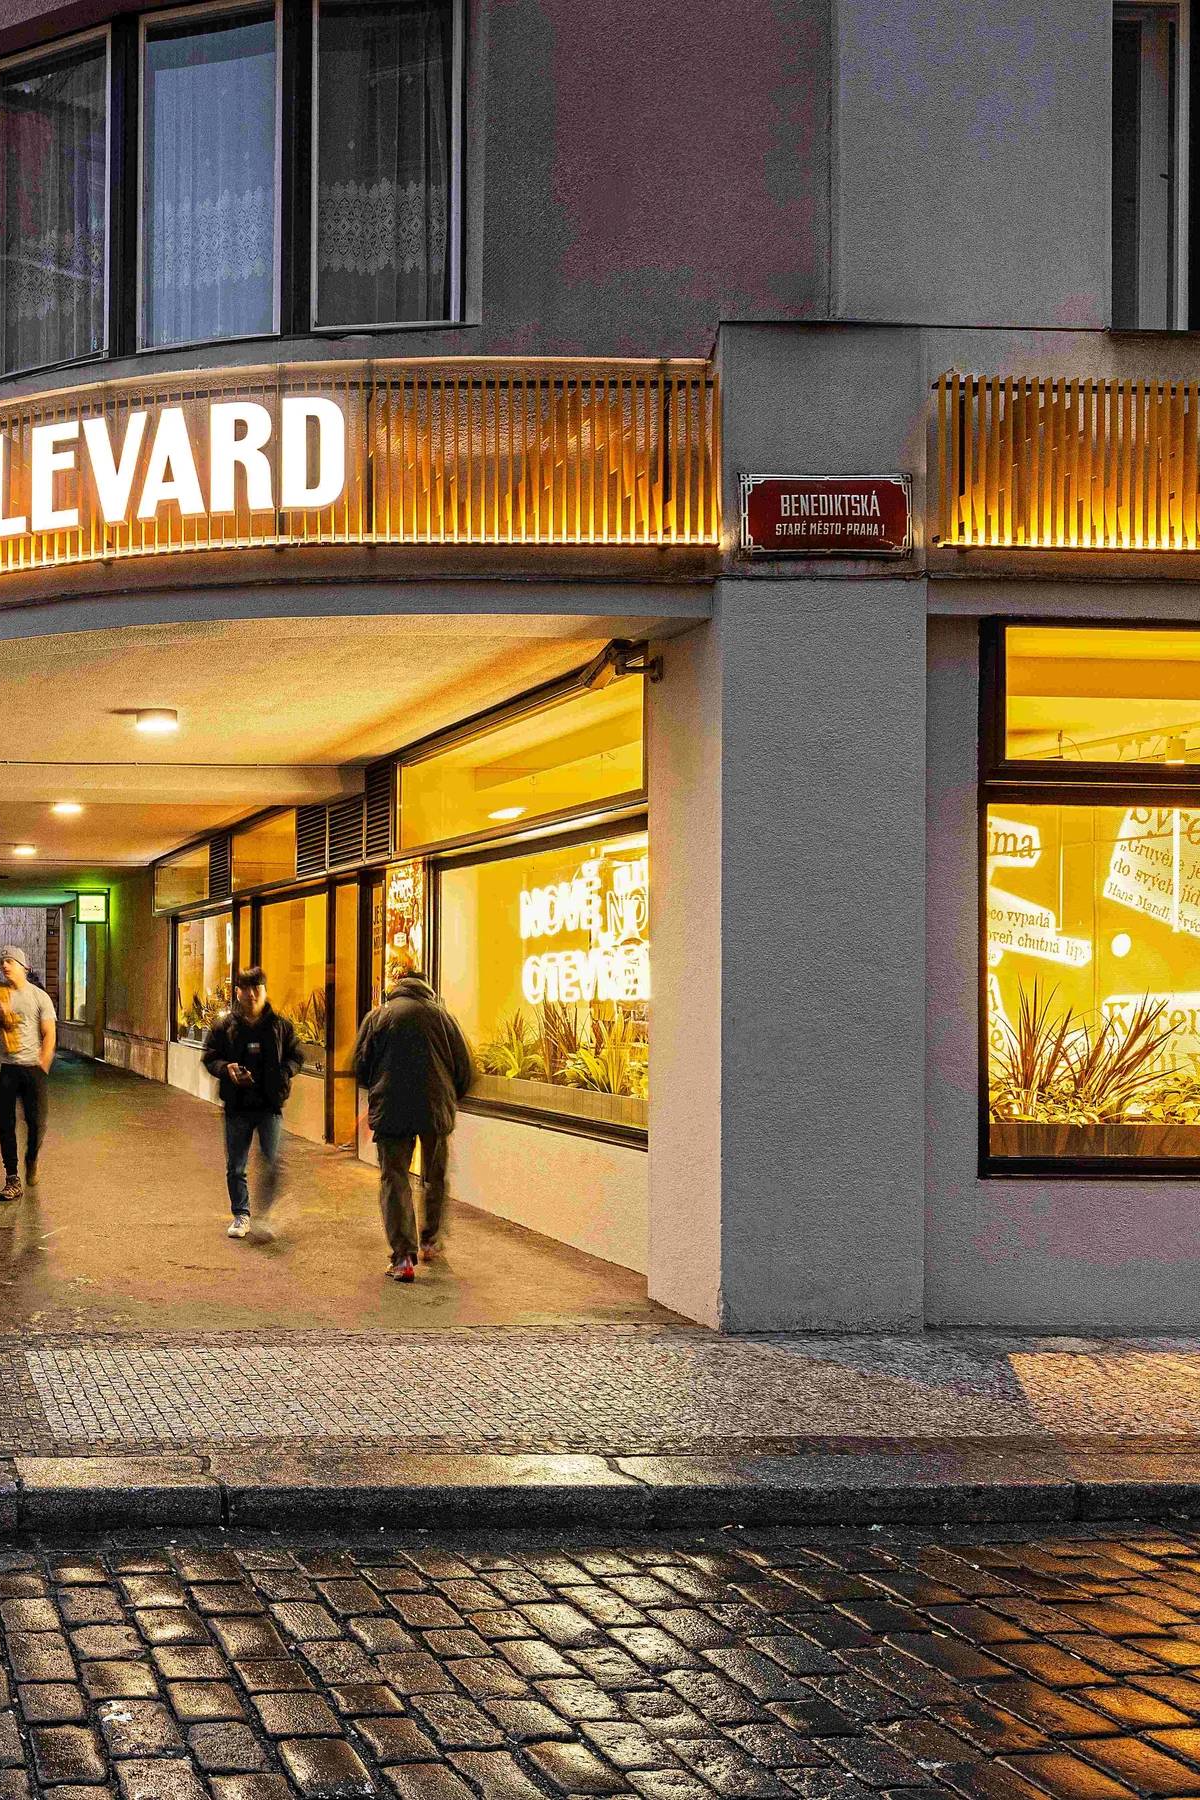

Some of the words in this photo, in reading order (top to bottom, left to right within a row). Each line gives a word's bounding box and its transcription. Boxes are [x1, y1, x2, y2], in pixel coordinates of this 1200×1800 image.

[780, 490, 880, 517] BENEDIKTSKÁ
[776, 520, 807, 536] STARÉ
[881, 523, 885, 536] 1
[1113, 858, 1131, 876] do
[1006, 910, 1050, 929] vypadá
[1018, 933, 1061, 954] chutná
